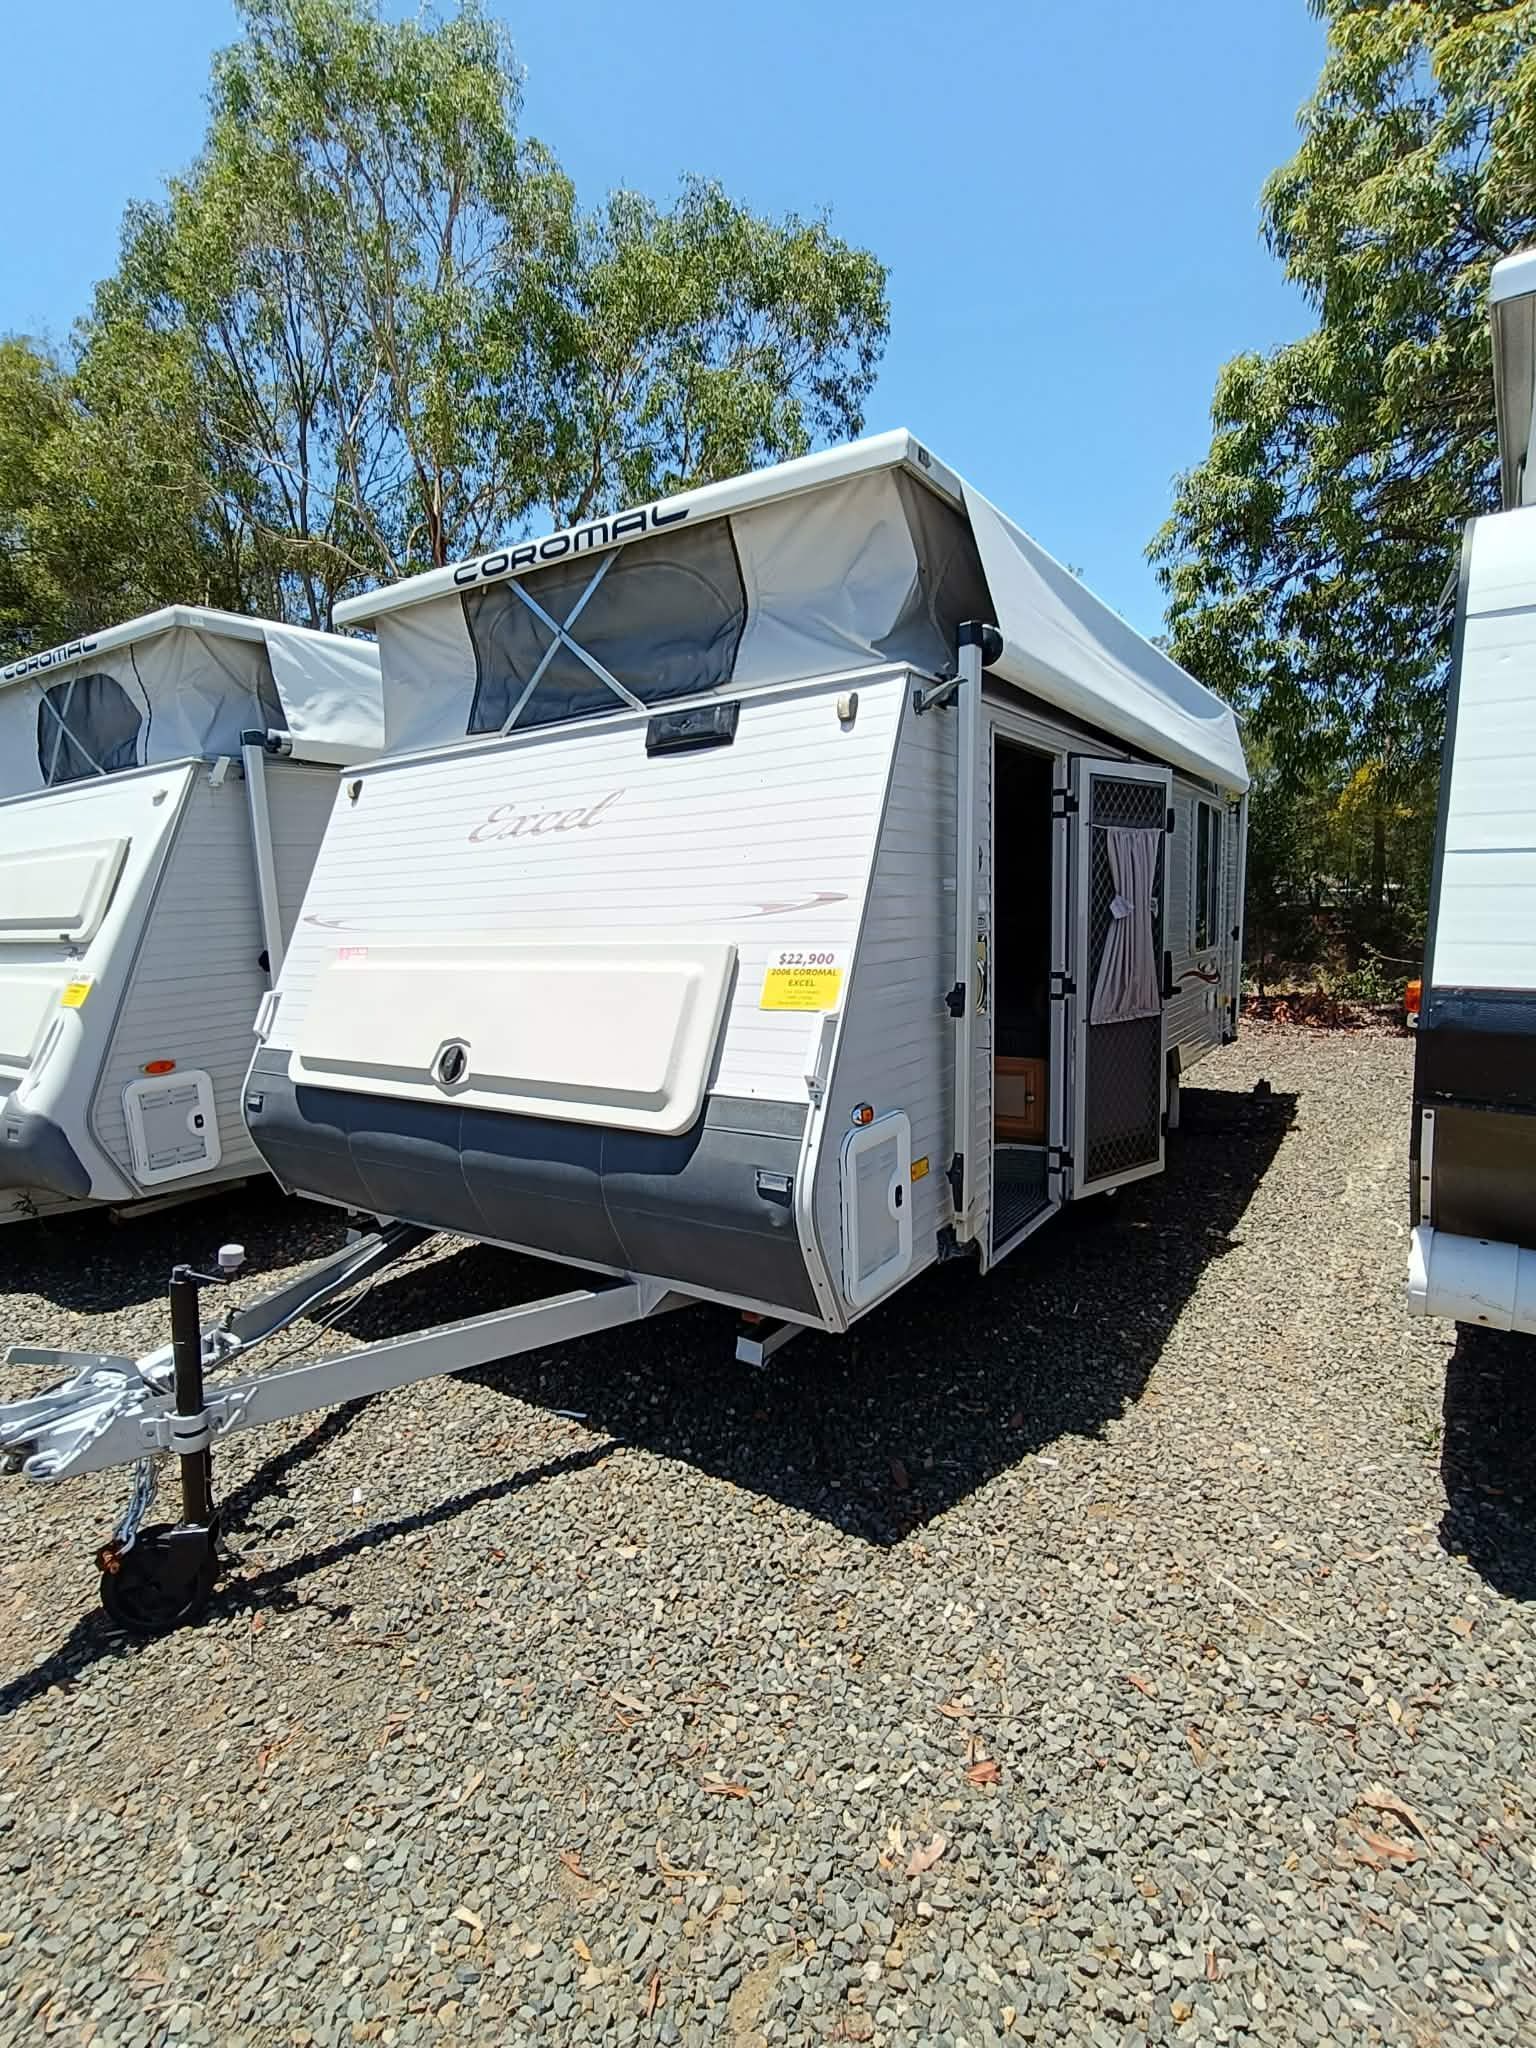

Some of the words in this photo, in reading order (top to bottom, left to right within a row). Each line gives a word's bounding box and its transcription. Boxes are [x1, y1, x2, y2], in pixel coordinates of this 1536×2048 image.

[453, 506, 690, 586] COROMAL
[3, 639, 98, 680] COROMAL
[468, 787, 627, 843] Excel
[779, 952, 835, 967] $22,900
[793, 968, 838, 976] COROMAL
[788, 979, 815, 987] EXCEL
